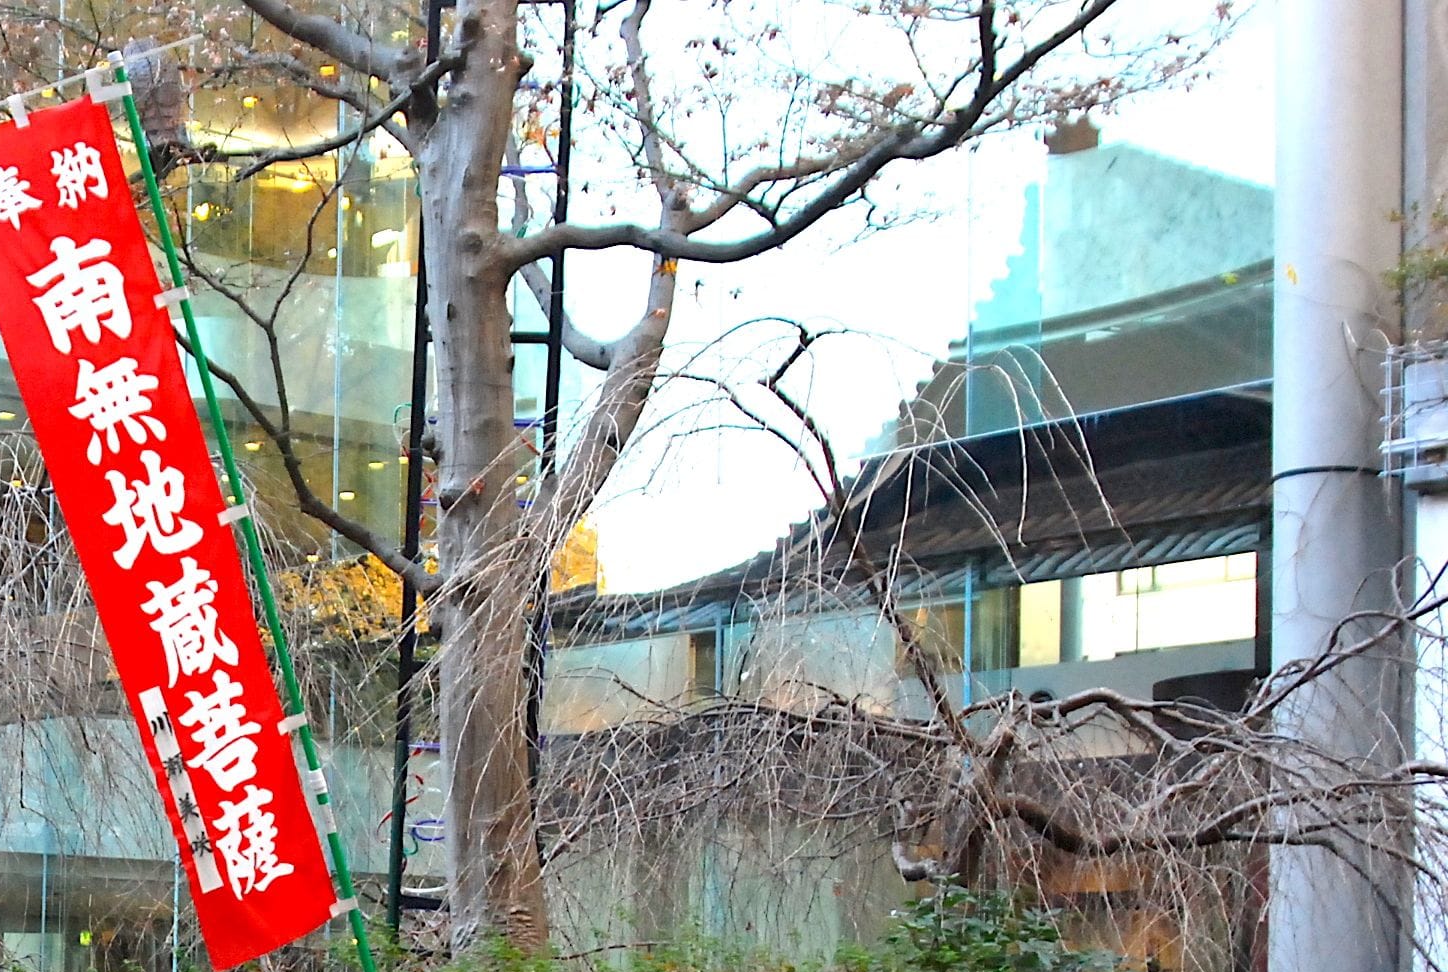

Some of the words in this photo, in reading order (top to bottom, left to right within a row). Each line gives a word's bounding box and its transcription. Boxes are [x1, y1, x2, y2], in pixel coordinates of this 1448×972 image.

[26, 235, 295, 901] 南無地蔵菩薩
[150, 710, 214, 856] 川瀬美咲
